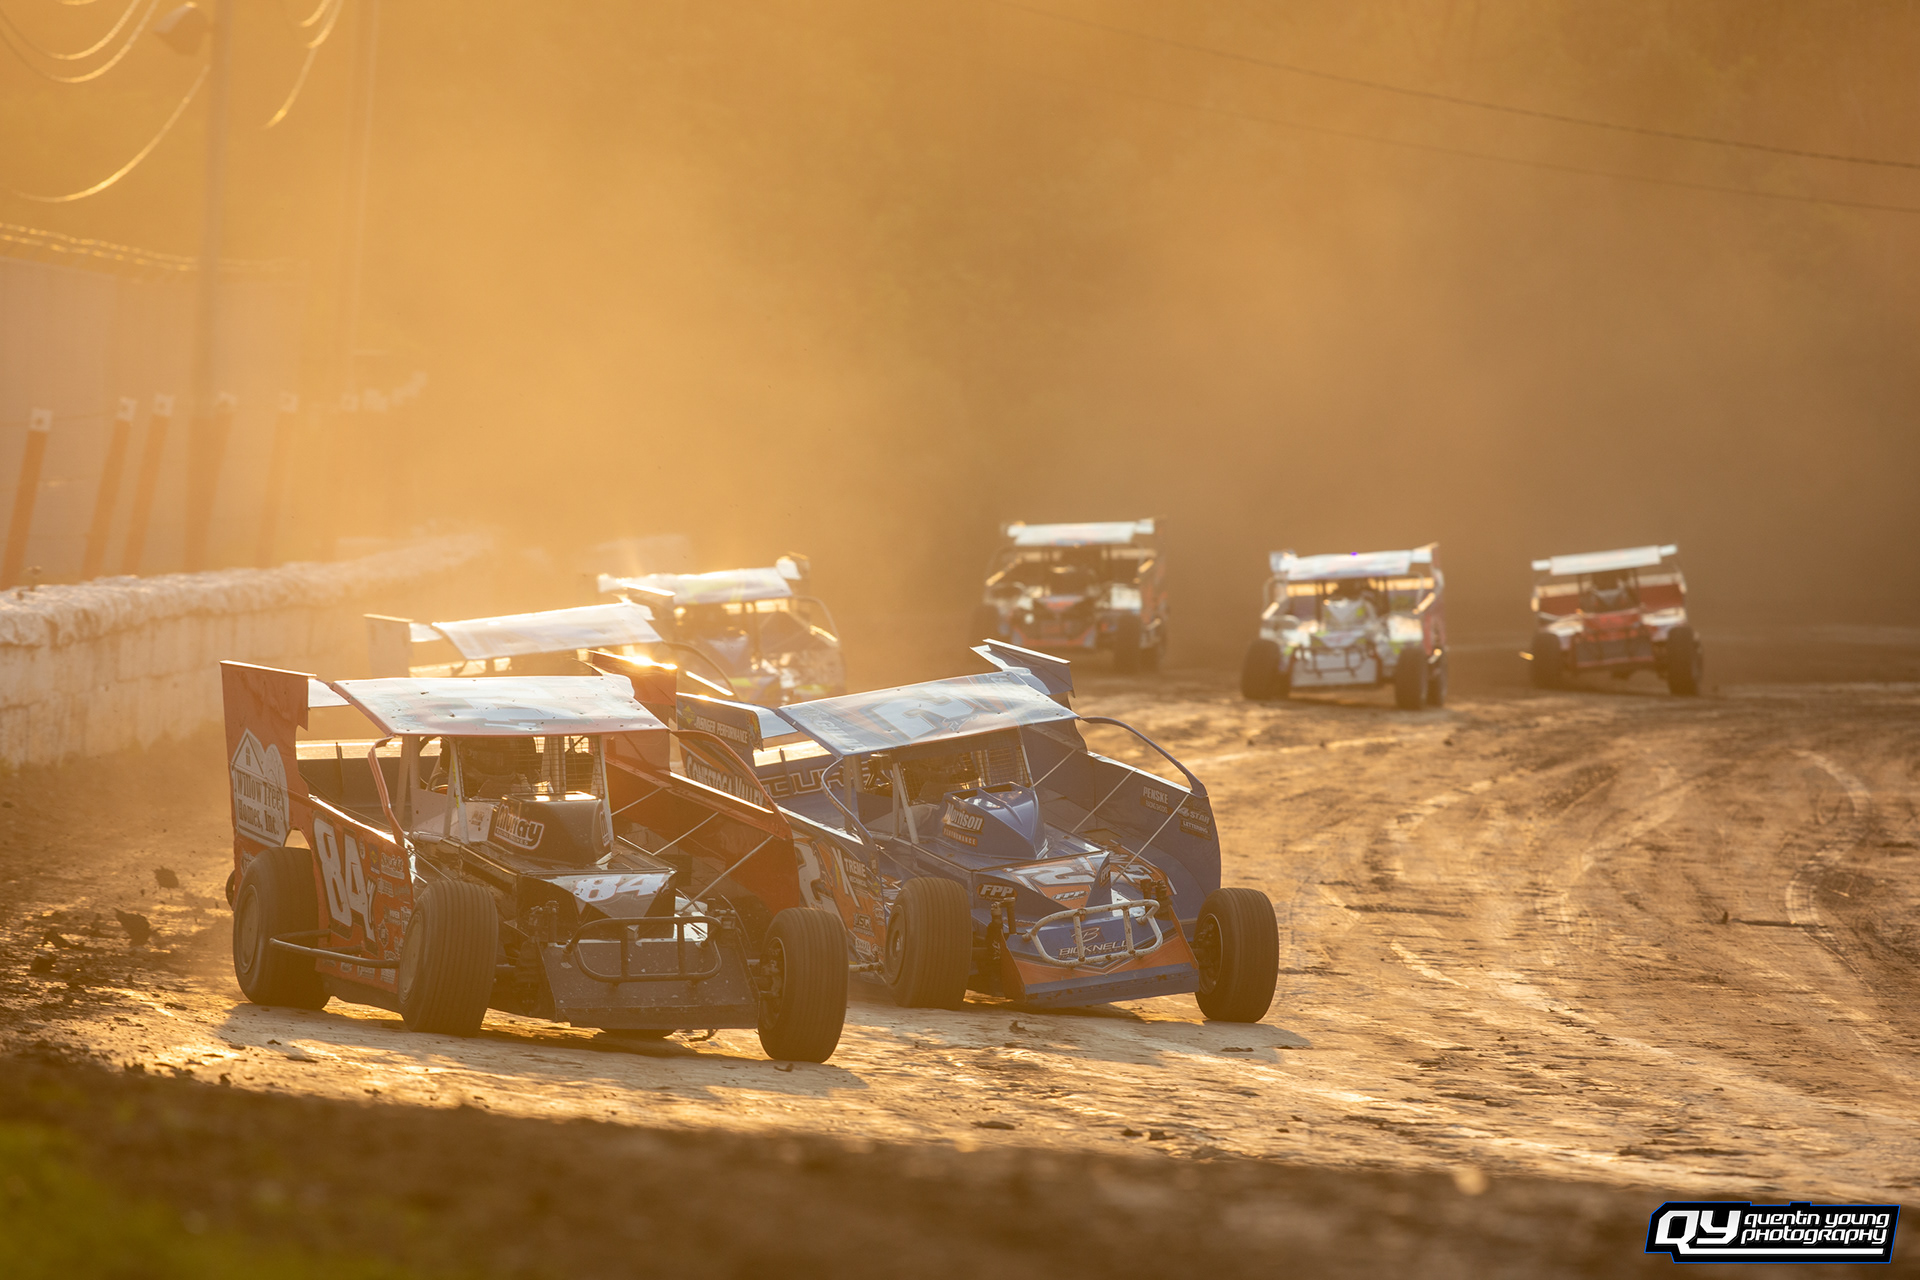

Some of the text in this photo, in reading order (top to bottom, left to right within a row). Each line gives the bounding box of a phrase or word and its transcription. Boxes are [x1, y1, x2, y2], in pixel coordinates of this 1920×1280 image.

[263, 781, 282, 811] Tree
[1142, 785, 1169, 805] PENSKE
[496, 804, 543, 847] Murray
[943, 801, 983, 831] Morrison
[980, 884, 1014, 897] FPP
